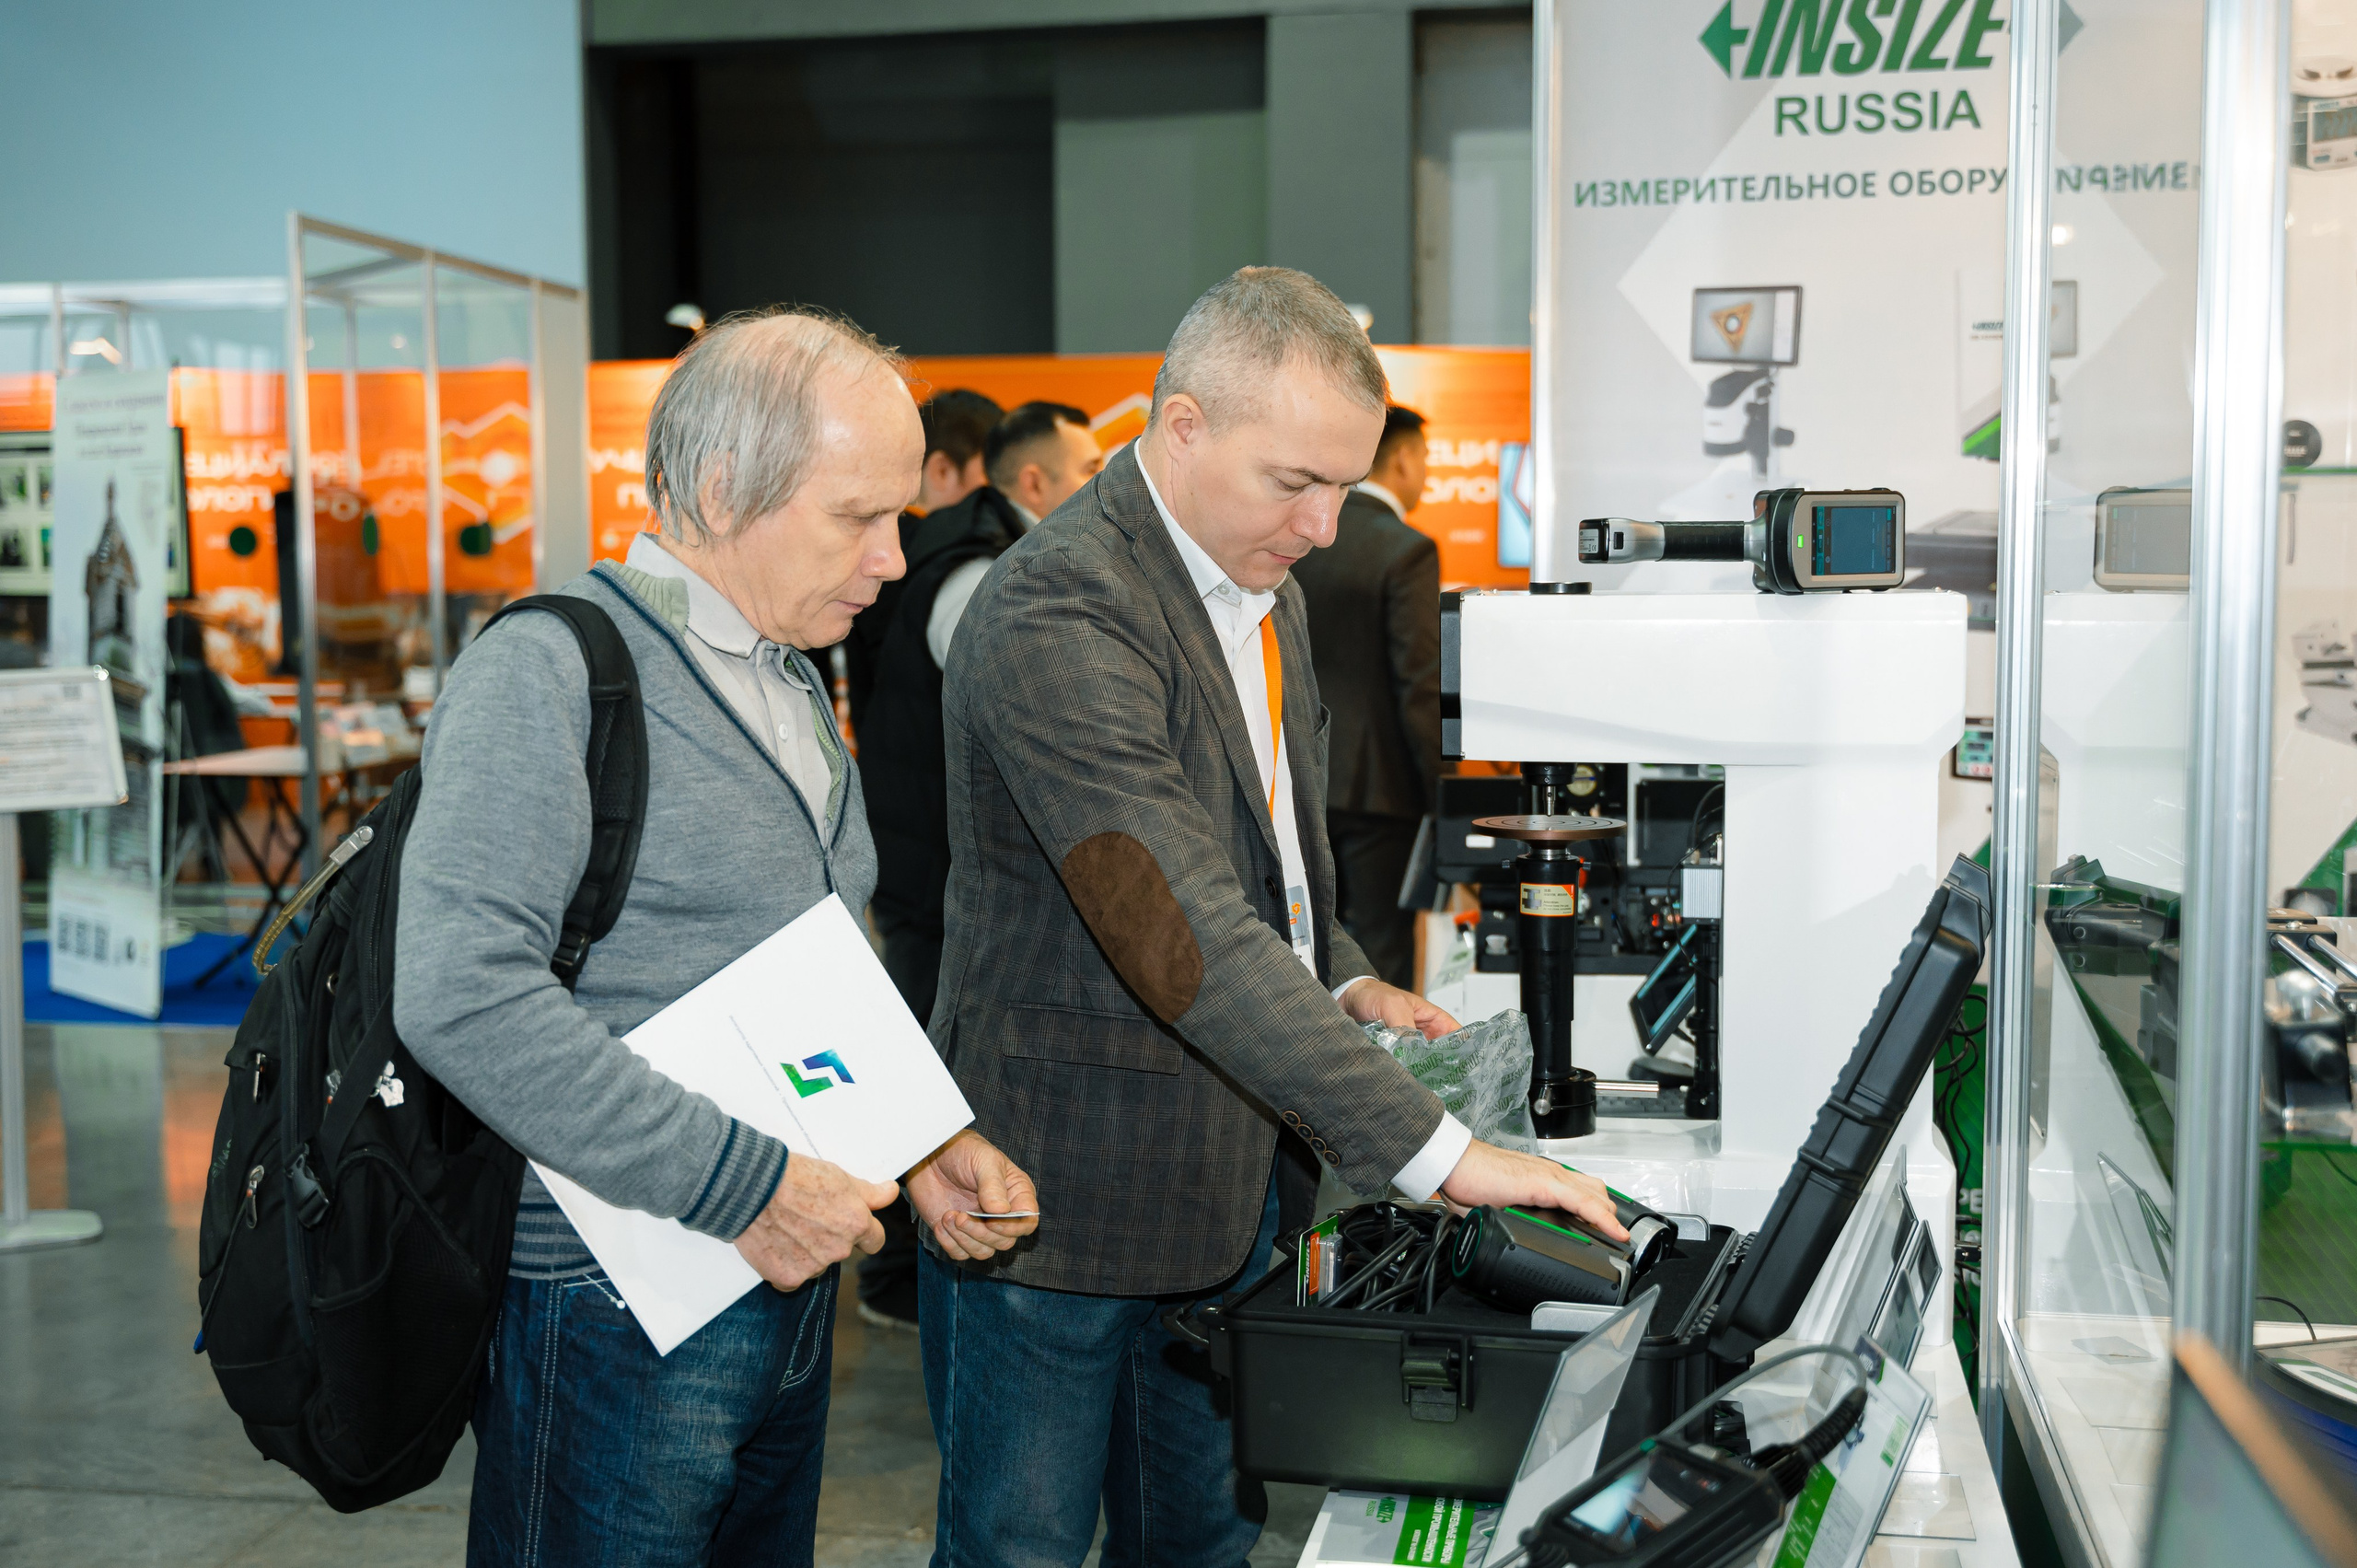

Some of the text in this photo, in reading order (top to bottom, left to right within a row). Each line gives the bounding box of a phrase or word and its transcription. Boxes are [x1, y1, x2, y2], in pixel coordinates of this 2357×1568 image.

[1740, 0, 2004, 79] INSIZE
[1775, 90, 1981, 136] RUSSIA
[1574, 172, 1876, 208] ИЗМЕРИТЕЛЬНОЕ
